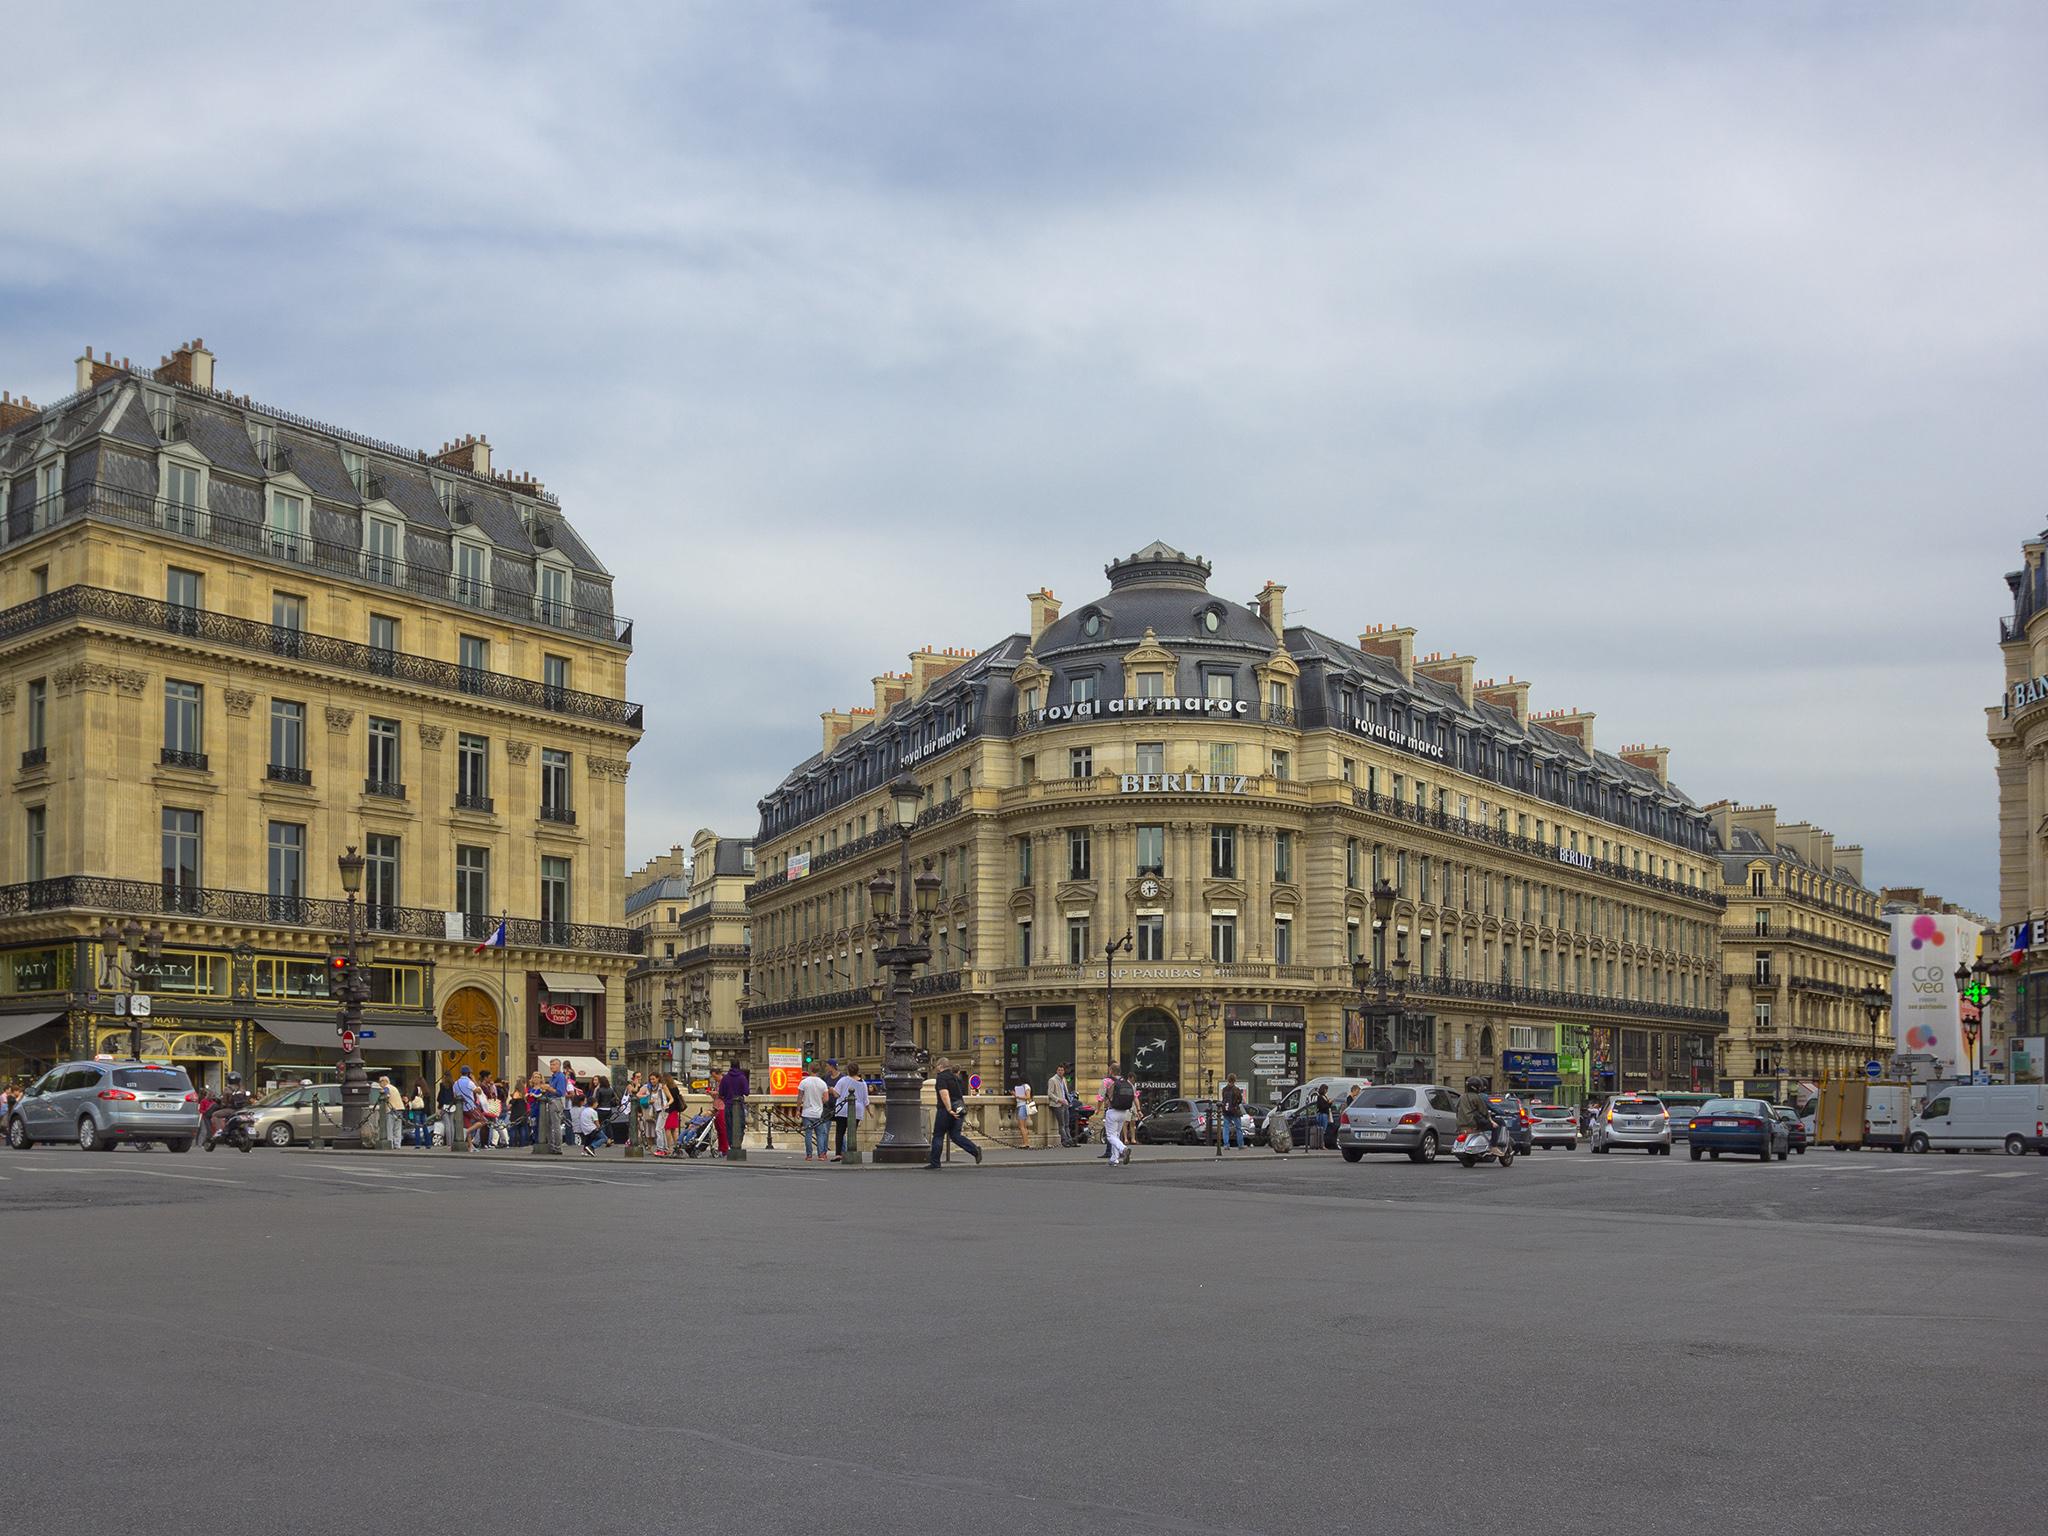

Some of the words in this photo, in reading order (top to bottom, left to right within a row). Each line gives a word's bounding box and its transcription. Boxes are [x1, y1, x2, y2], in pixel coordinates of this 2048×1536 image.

[1038, 699, 1101, 721] royal
[1108, 696, 1148, 712] air
[1156, 697, 1248, 713] maroc
[900, 745, 922, 769] royal
[923, 739, 936, 756] air
[937, 723, 967, 750] maroc
[1355, 717, 1386, 739] royal
[1388, 730, 1406, 745] air
[1407, 736, 1444, 758] maroc
[1120, 773, 1249, 796] BERLITZ
[1560, 847, 1593, 870] BERLITZ
[14, 962, 48, 977] MATY
[1096, 968, 1128, 979] BNP
[1133, 968, 1201, 979] PARIBAS
